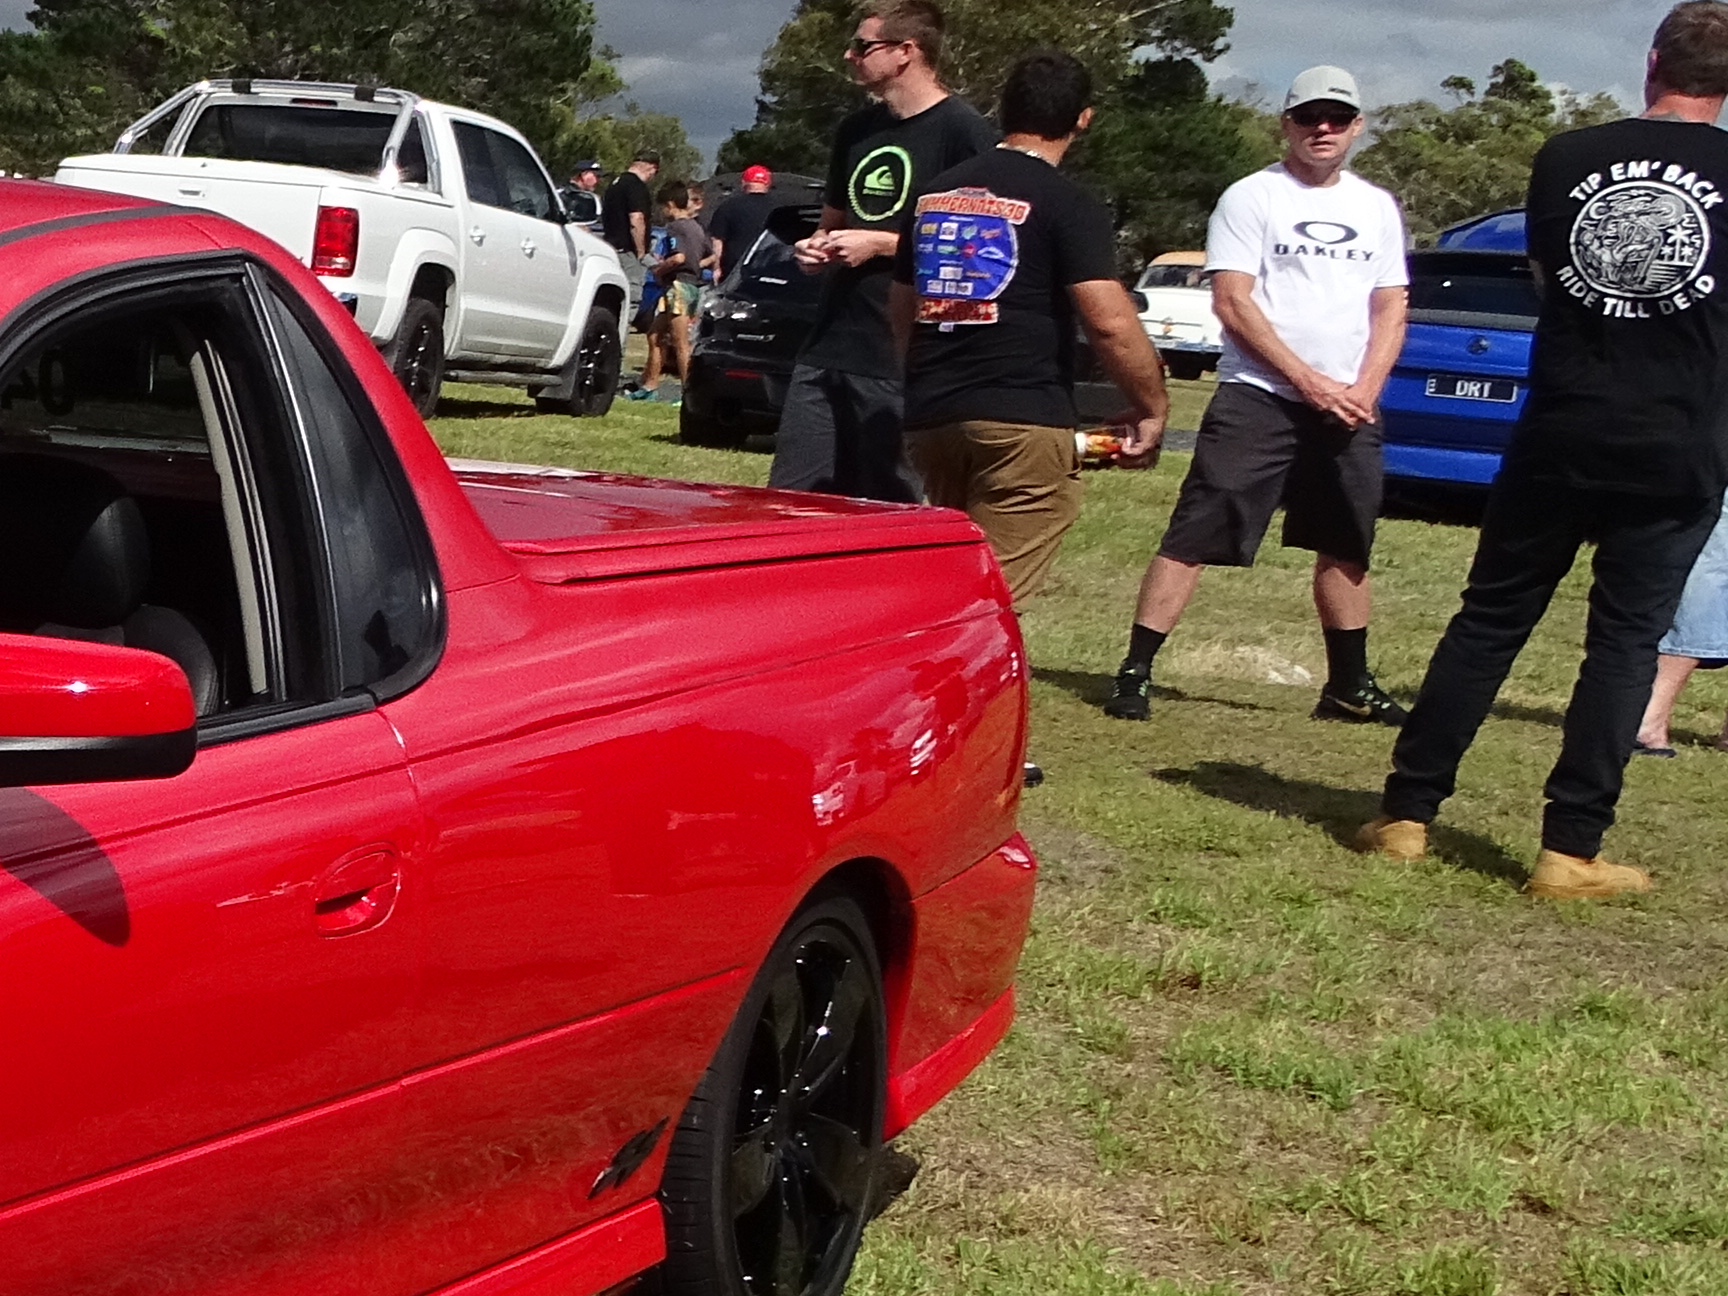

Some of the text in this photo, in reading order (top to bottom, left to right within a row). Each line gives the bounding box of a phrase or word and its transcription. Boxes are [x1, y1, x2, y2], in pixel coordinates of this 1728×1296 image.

[1569, 172, 1603, 201] TIP
[1662, 164, 1724, 210] BACK
[1274, 244, 1374, 262] OAKLEY
[1556, 265, 1716, 318] RIDE TILL DEAD
[1455, 379, 1493, 398] DRT
